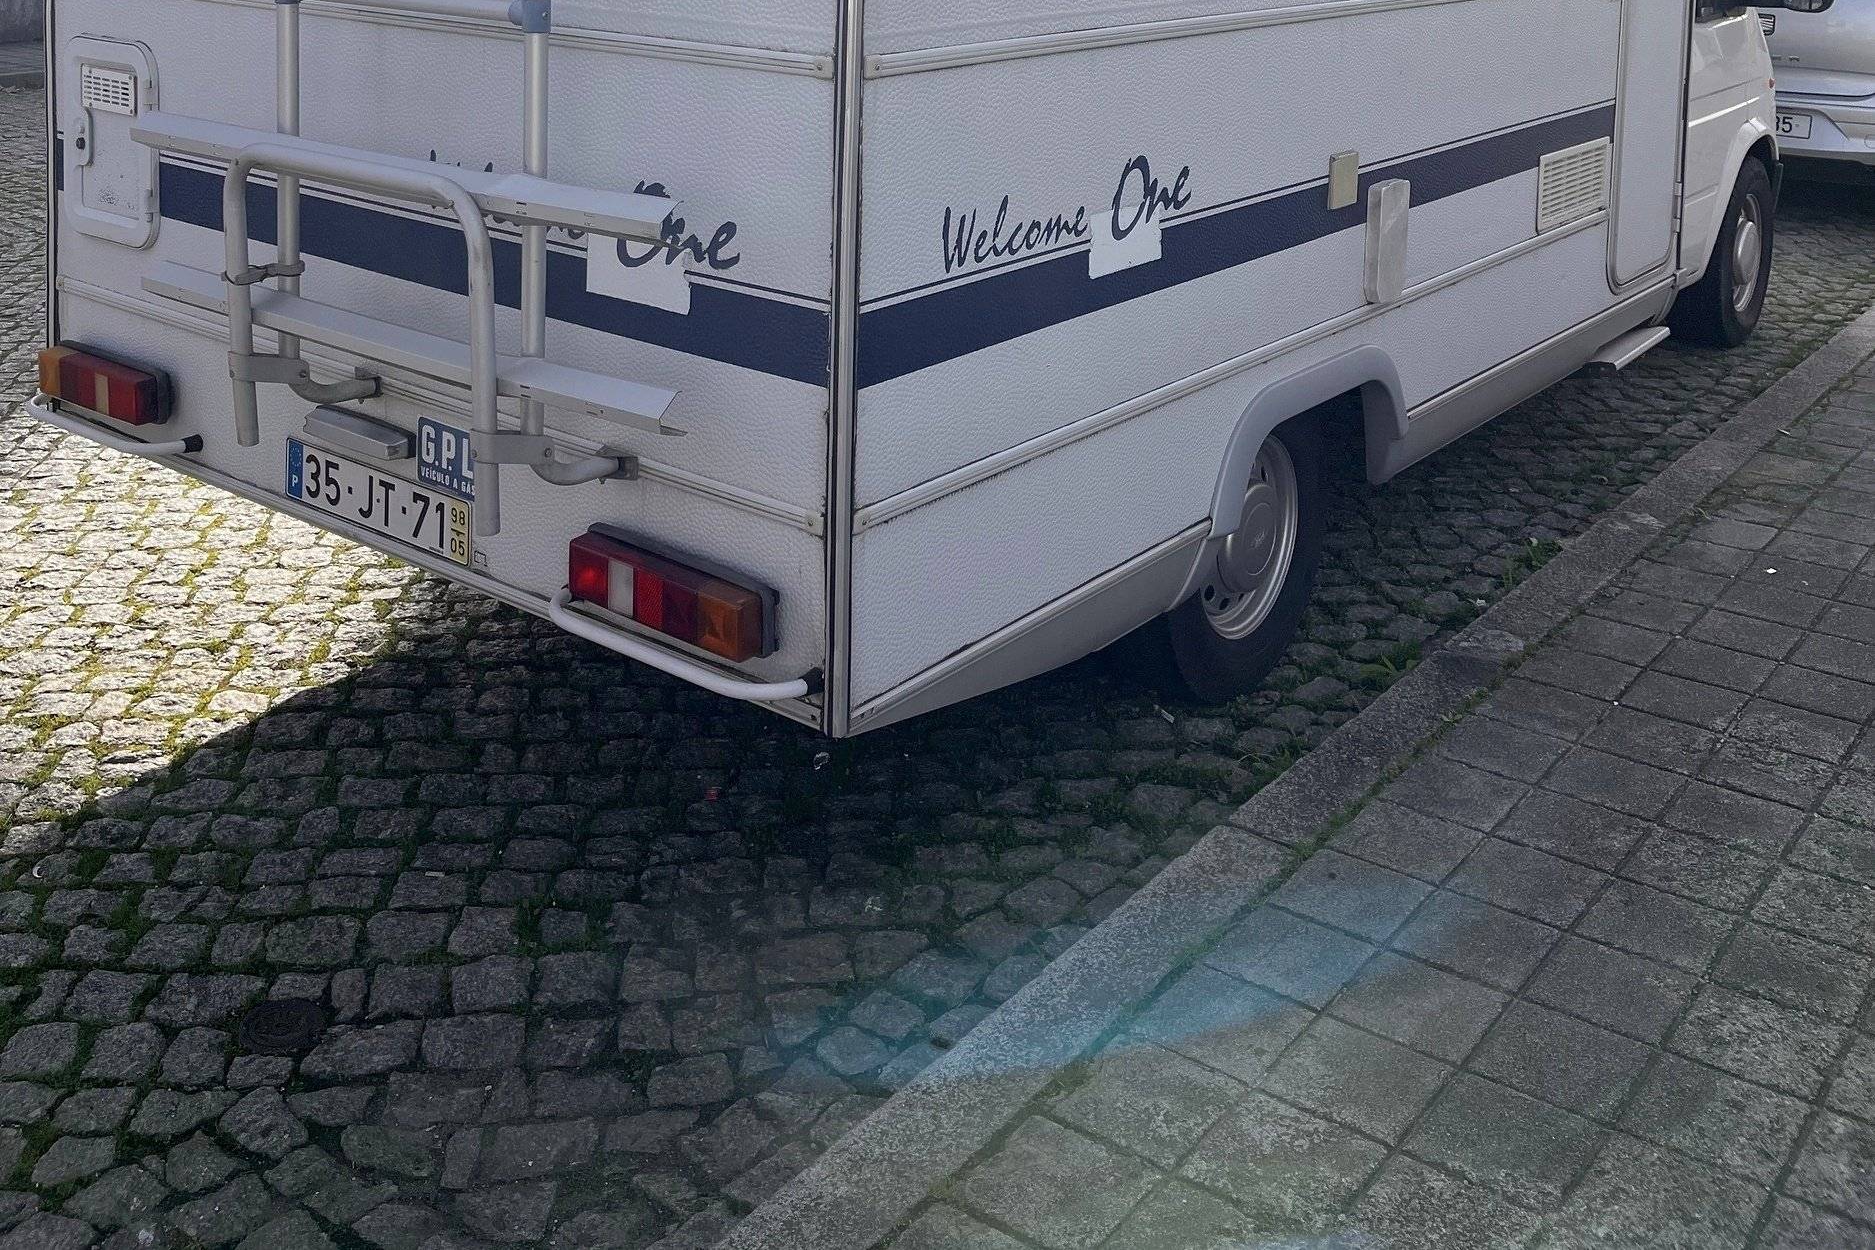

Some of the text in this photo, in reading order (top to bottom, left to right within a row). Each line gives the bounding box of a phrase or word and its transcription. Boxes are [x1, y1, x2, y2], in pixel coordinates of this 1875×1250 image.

[942, 155, 1192, 274] Welcome One
[291, 474, 299, 488] P
[452, 478, 458, 490] A
[450, 506, 466, 526] 98
[450, 536, 466, 557] 05
